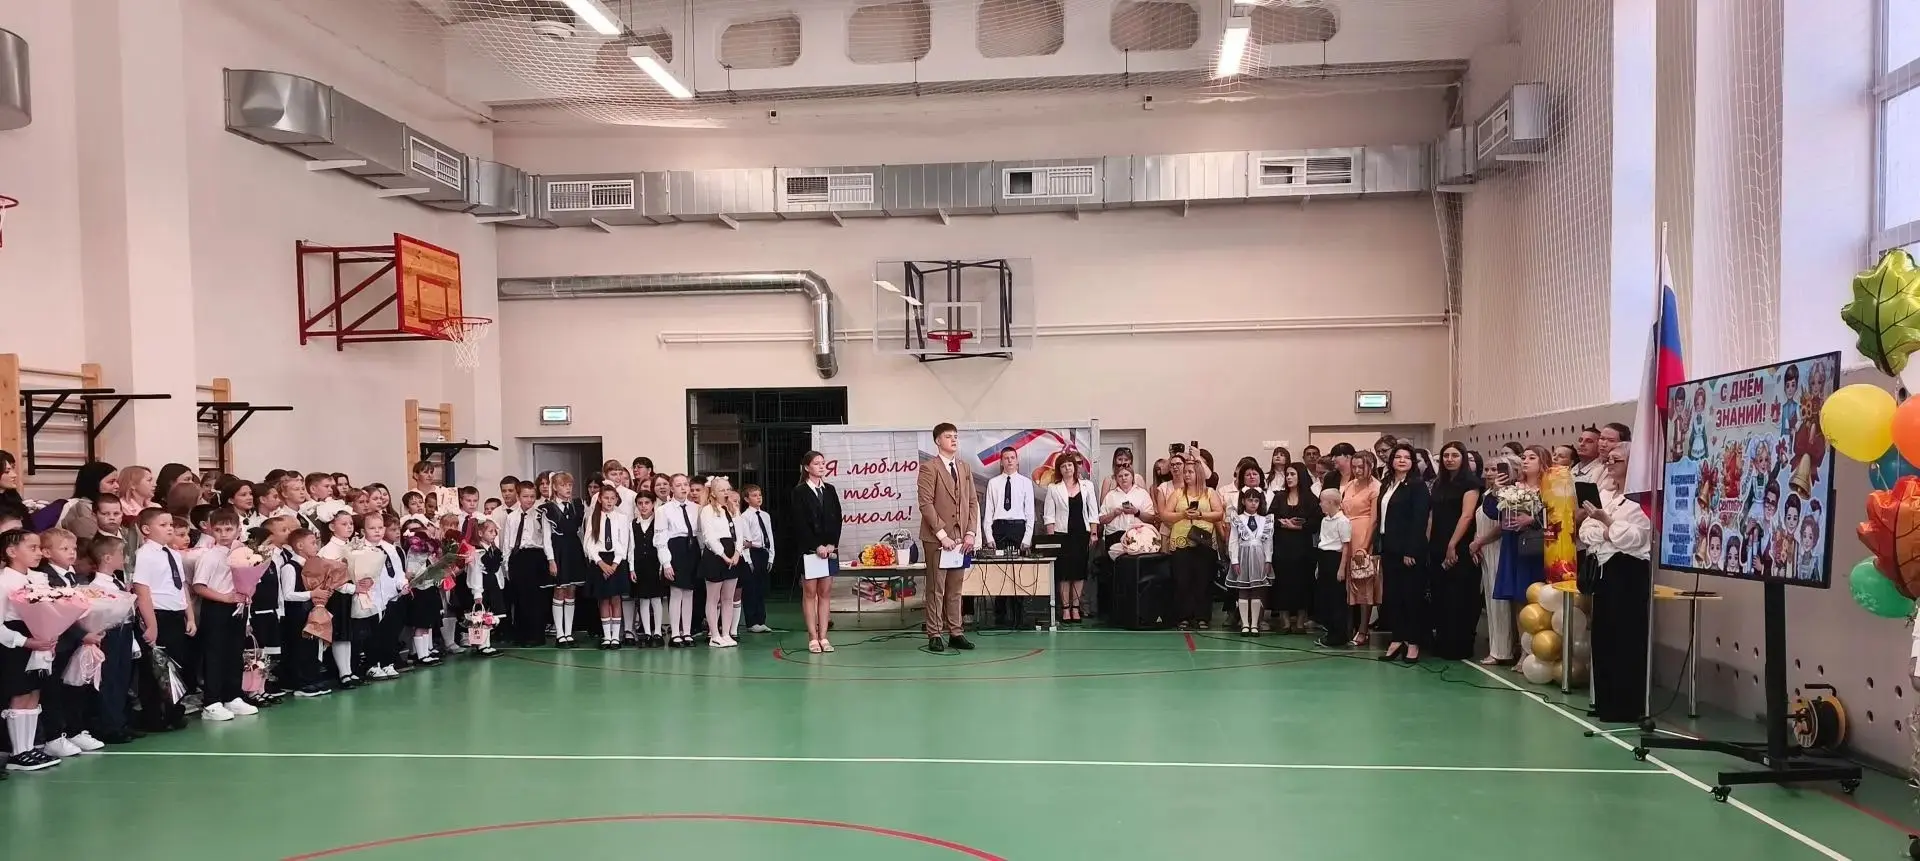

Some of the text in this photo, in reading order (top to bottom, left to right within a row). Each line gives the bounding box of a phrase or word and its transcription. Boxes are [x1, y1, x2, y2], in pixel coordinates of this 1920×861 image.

[1720, 372, 1764, 403] С ДНЁМ
[1715, 398, 1766, 428] ЗНАНИЙ!
[825, 457, 918, 477] Я люблю
[843, 482, 902, 500] тебя,
